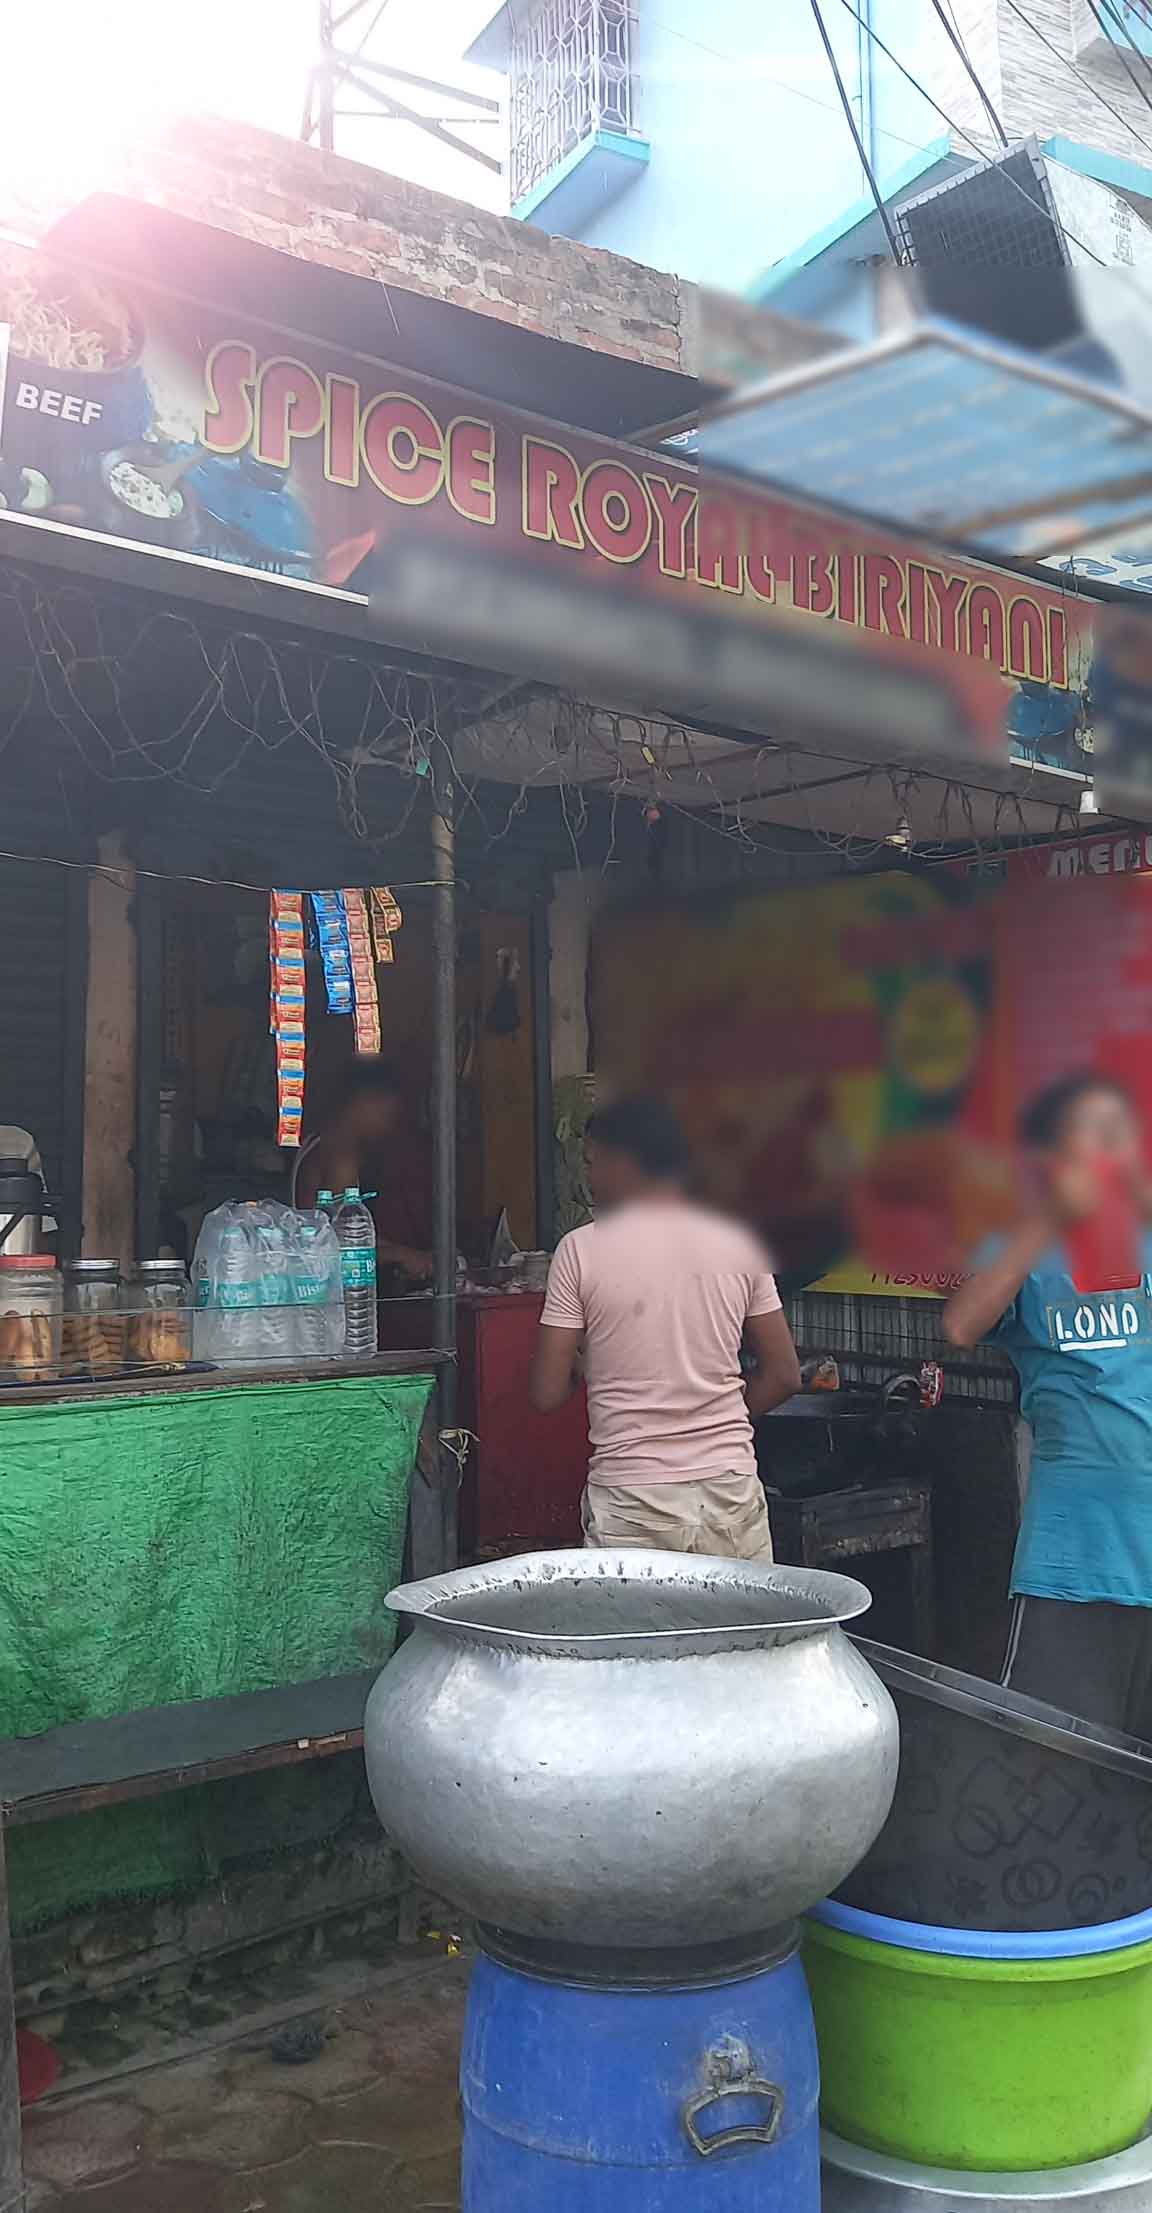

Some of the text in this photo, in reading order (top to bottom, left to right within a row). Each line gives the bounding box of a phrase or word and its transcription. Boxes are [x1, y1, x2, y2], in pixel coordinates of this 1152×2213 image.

[16, 382, 103, 425] BEEF
[200, 339, 496, 525] SPICE
[1055, 1303, 1139, 1340] LOND
